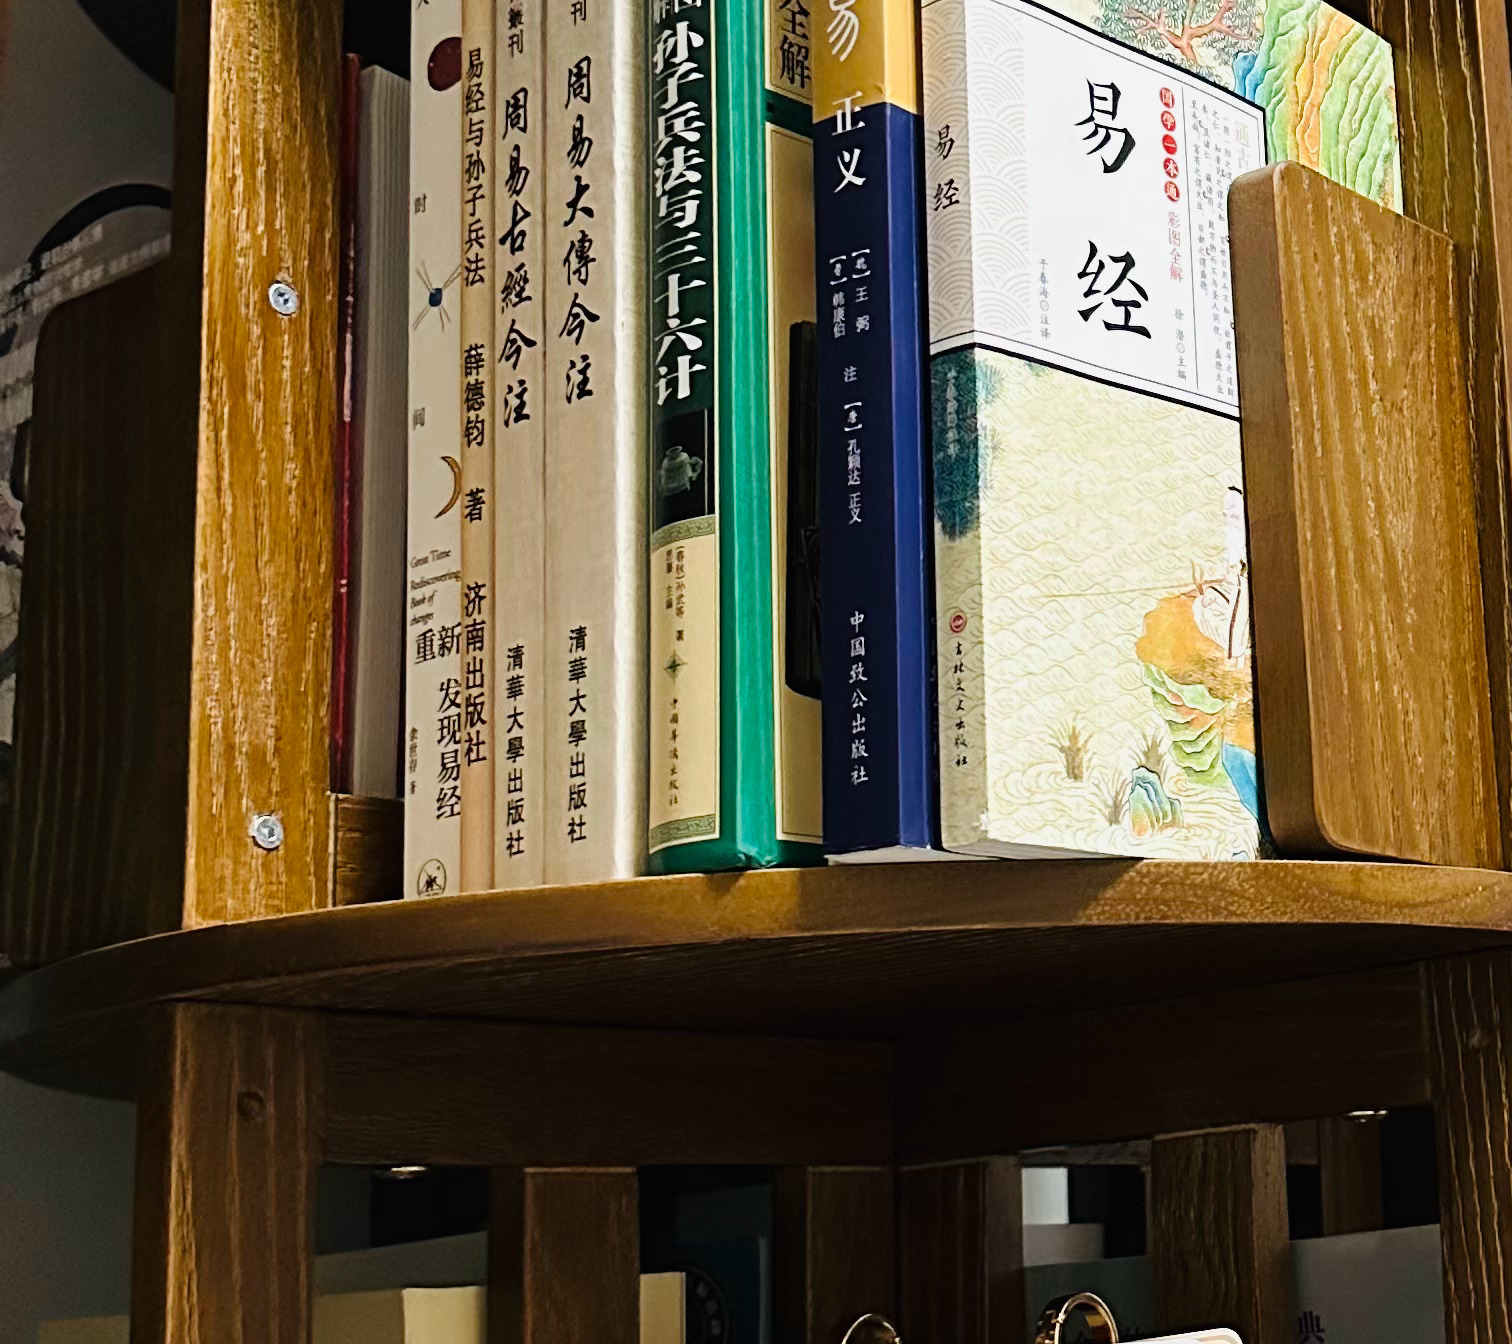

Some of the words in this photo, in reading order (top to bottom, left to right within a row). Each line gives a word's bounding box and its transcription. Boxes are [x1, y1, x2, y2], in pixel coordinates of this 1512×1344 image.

[464, 47, 486, 287] 易经与孙子兵法
[559, 56, 600, 404] 周易大傳今注
[653, 21, 706, 406] 孙子兵法与三十六计
[831, 92, 866, 193] 正义
[933, 123, 960, 212] 易经
[1075, 77, 1152, 341] 易经
[1161, 87, 1180, 203] 国学一本通
[499, 87, 538, 429] 周易古經今注
[1167, 211, 1184, 283] 彩图全解
[465, 487, 486, 524] 著
[848, 492, 862, 524] 正义
[414, 622, 461, 665] 重新
[464, 581, 487, 767] 济南出版社
[849, 610, 868, 785] 中国致公出版社
[435, 677, 462, 820] 发现易经
[506, 645, 525, 858] 清華大學出版社
[568, 626, 588, 844] 清華大學出版社
